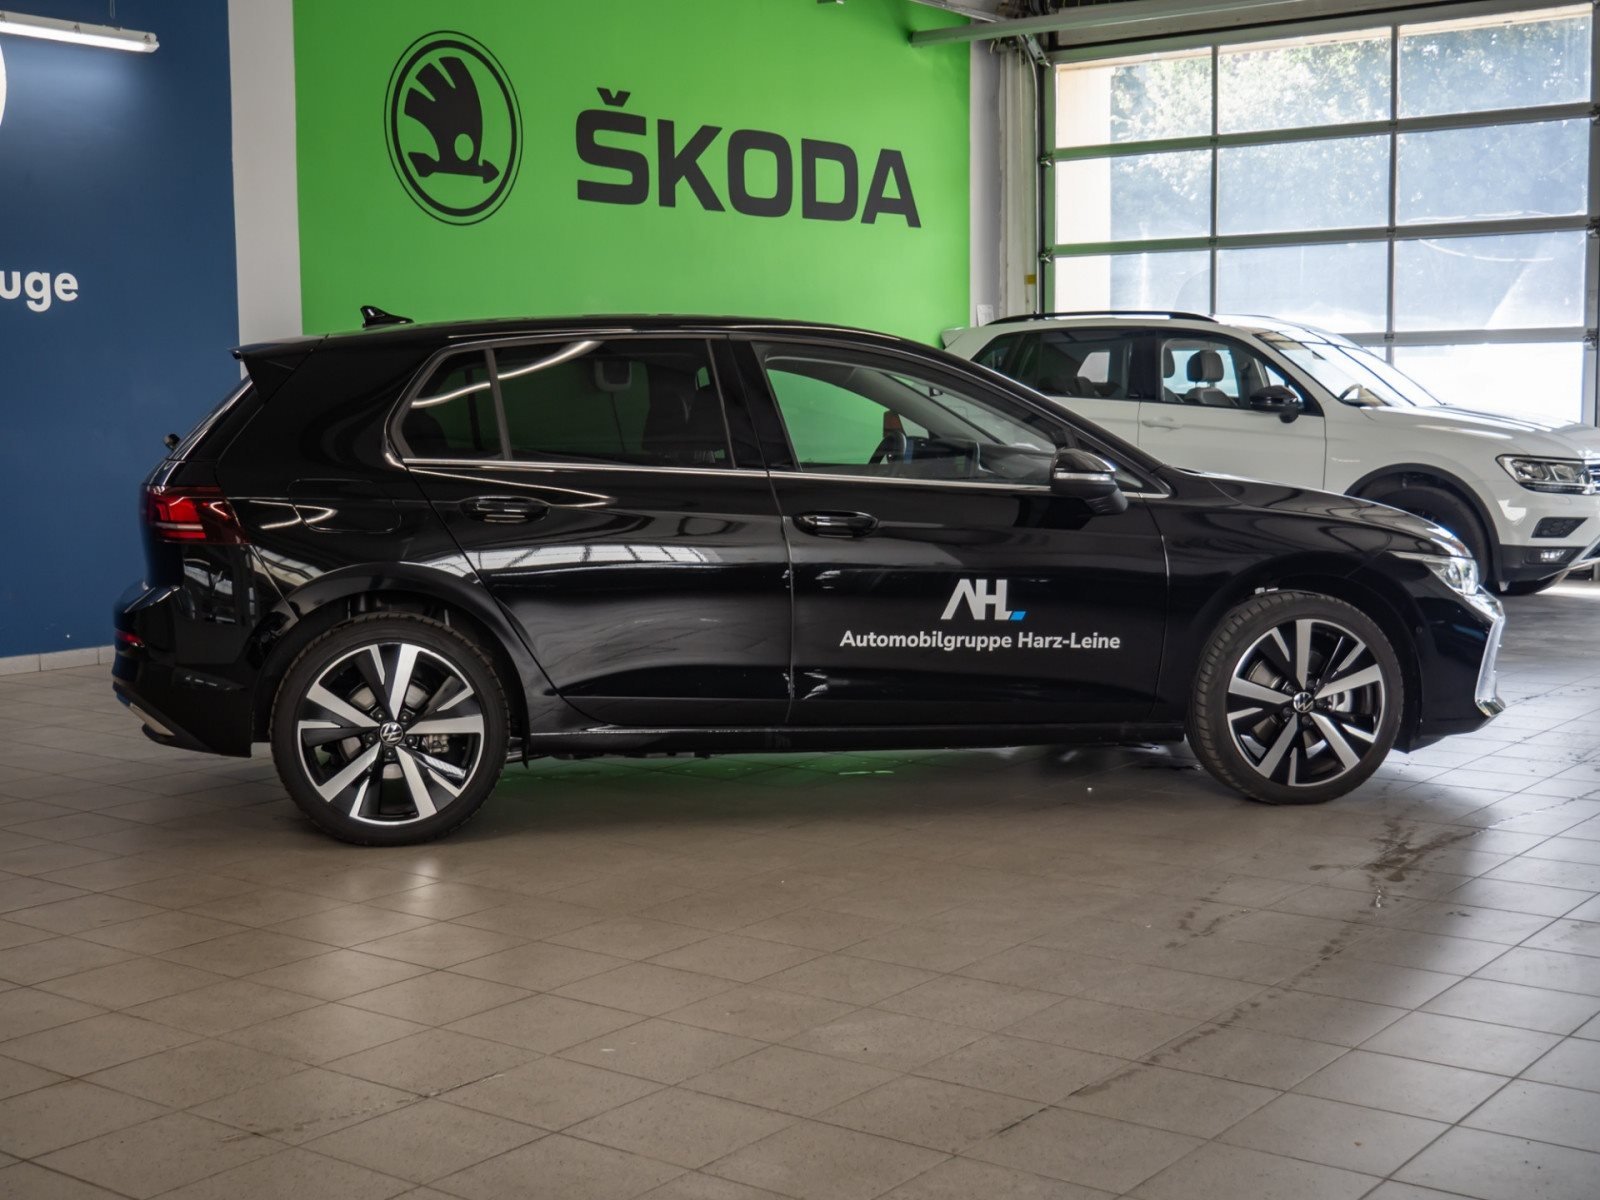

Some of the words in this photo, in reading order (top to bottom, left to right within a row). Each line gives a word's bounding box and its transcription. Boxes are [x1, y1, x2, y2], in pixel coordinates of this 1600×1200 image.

[575, 87, 922, 228] ŠKODA
[0, 270, 79, 313] uge
[839, 630, 1012, 652] Automobilgruppe
[1017, 631, 1121, 649] Harz-Leine
